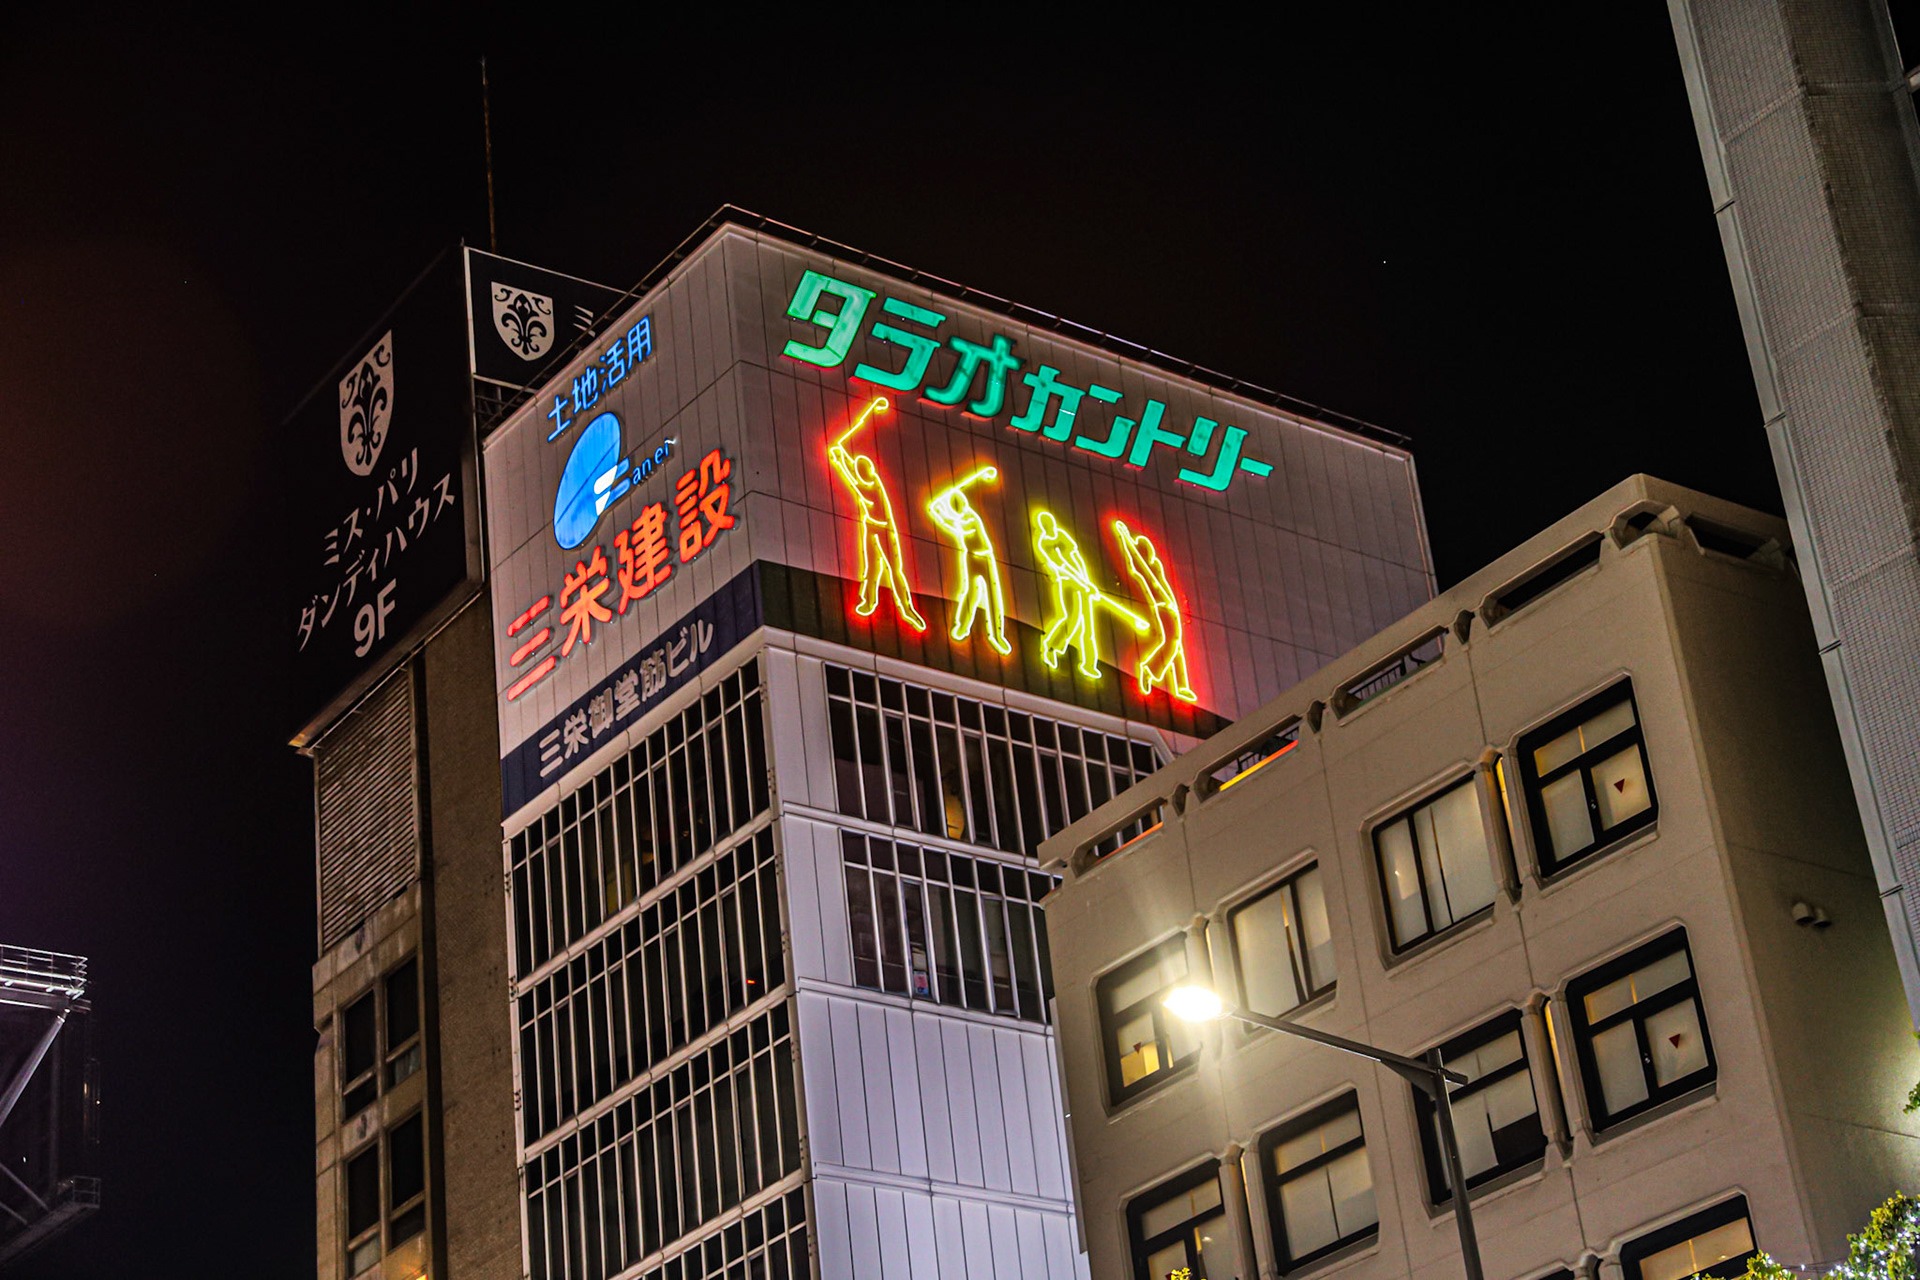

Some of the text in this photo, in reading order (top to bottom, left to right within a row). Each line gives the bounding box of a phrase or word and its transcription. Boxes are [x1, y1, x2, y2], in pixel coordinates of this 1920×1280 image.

[547, 314, 653, 443] 土地活用
[783, 270, 1274, 492] タラオカントリー
[297, 472, 455, 653] ダンディハウス
[323, 447, 418, 566] ミス・パリ
[507, 448, 736, 701] 三栄建設
[353, 578, 397, 658] 9F
[539, 619, 714, 778] 三栄御堂筋ビル
